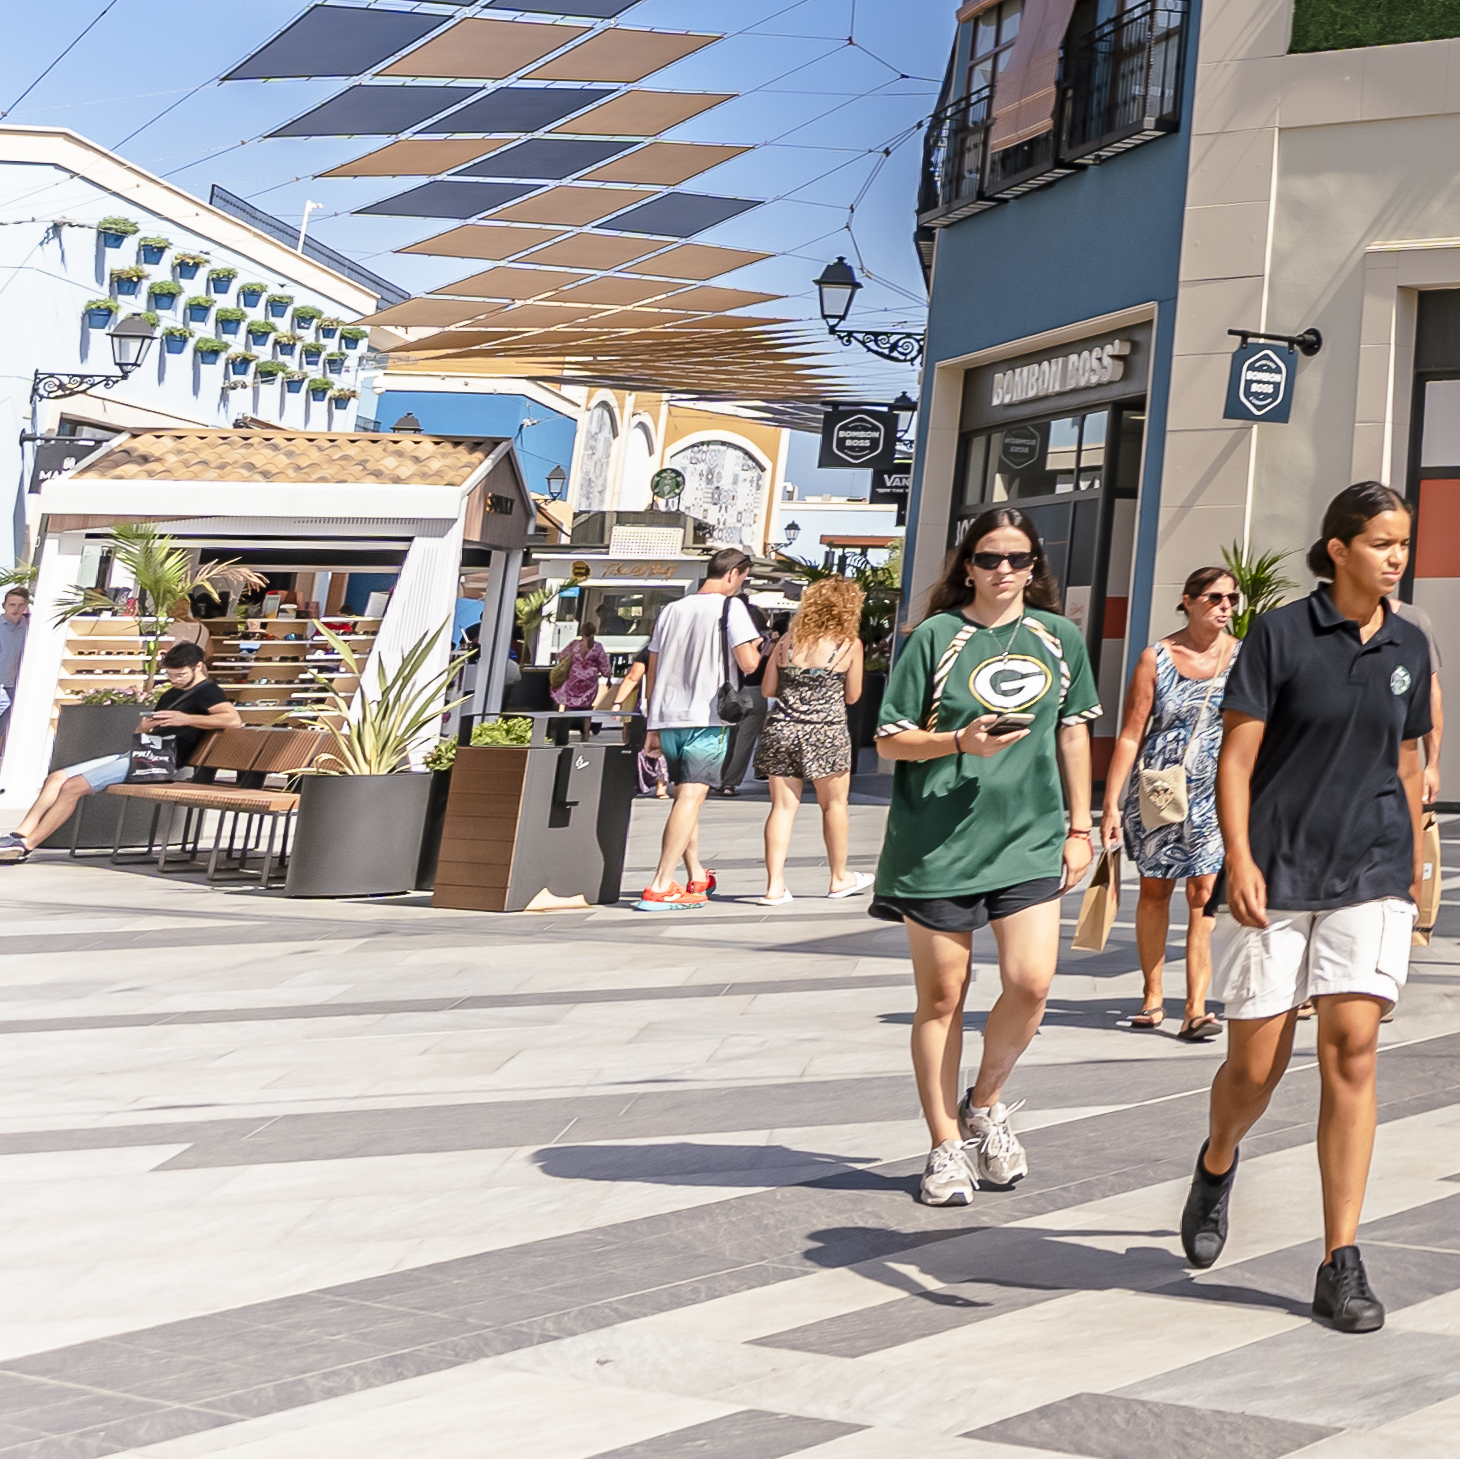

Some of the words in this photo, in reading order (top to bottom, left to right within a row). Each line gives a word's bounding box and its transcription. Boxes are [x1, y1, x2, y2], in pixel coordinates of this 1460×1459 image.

[991, 357, 1067, 406] BOMBON
[838, 430, 880, 439] BOMBON
[845, 439, 871, 447] BOSS
[972, 657, 1048, 710] G
